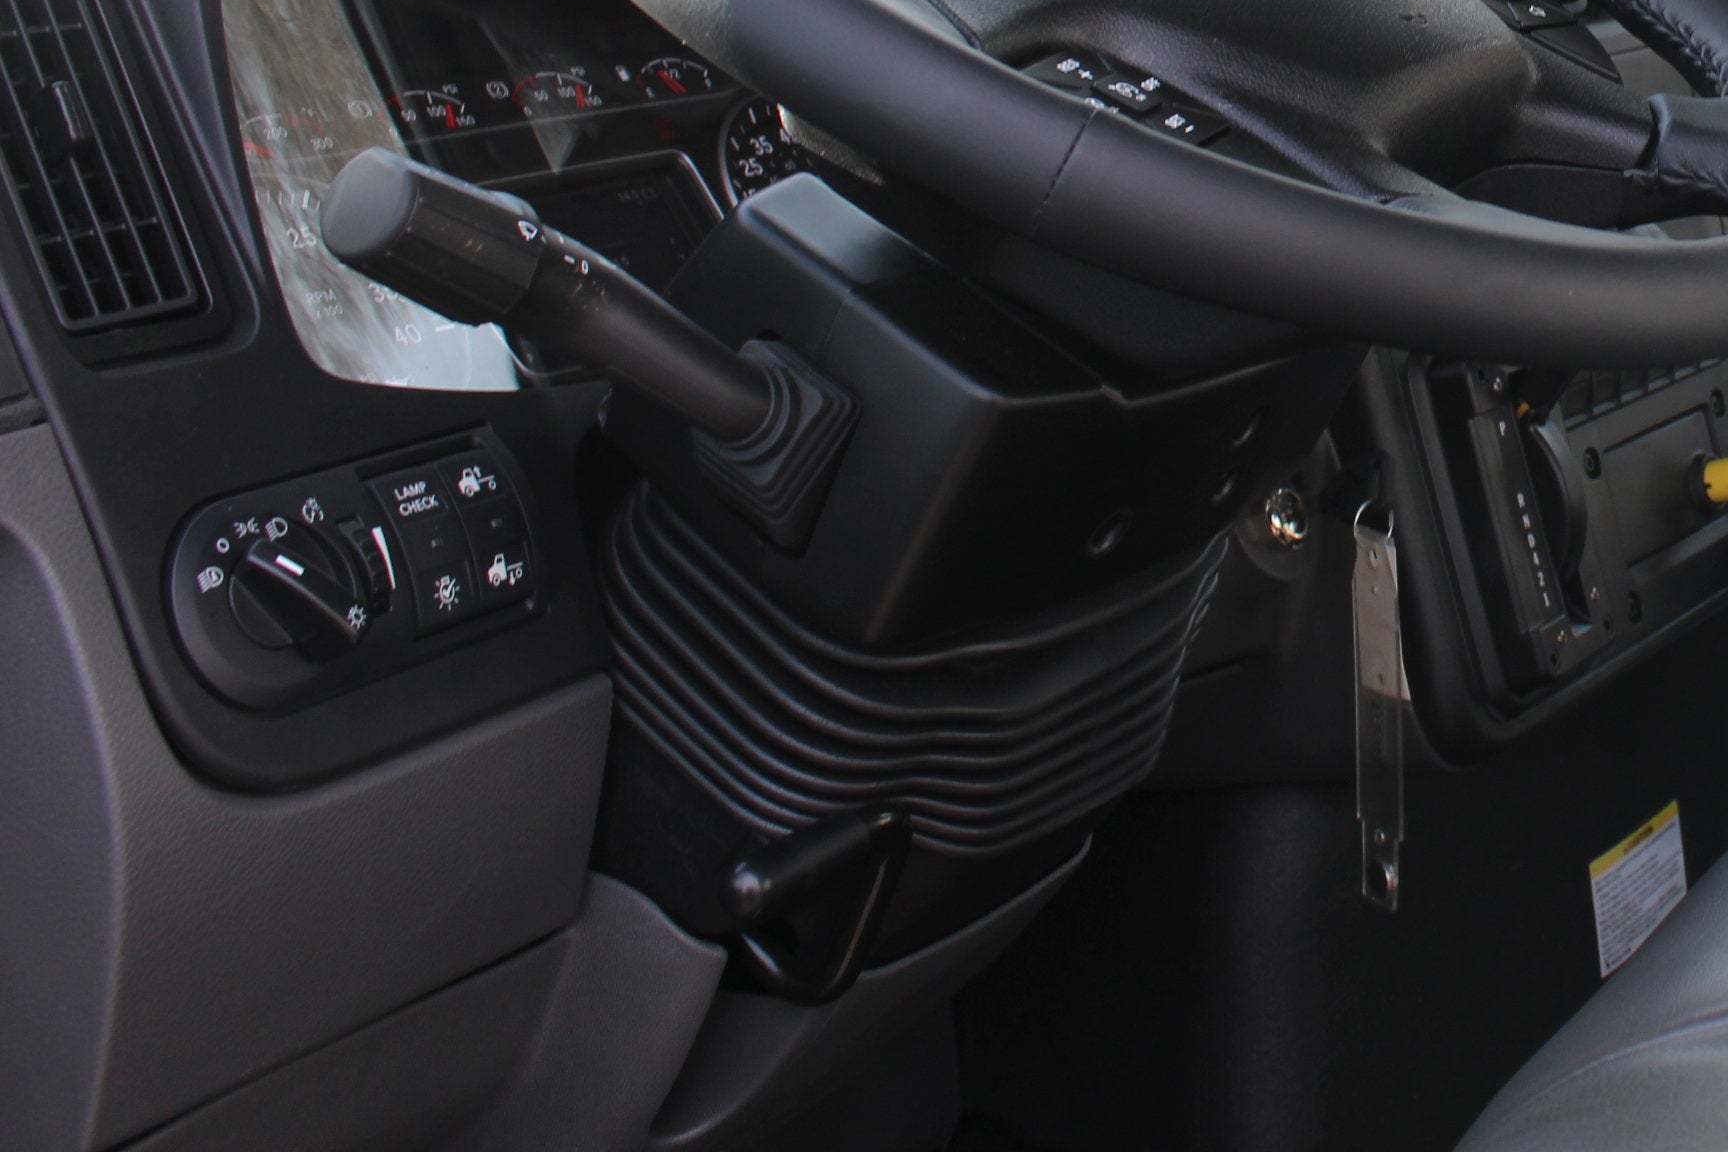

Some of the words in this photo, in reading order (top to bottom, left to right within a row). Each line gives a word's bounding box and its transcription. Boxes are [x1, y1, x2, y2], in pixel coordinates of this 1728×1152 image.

[750, 135, 774, 155] 35
[739, 157, 764, 178] 25
[286, 226, 318, 249] 25
[395, 324, 422, 346] 40
[394, 481, 426, 501] LAMP
[399, 494, 439, 516] CHECK
[1499, 420, 1507, 437] P
[1516, 492, 1526, 509] R
[1522, 513, 1531, 530] N
[1537, 571, 1546, 588] 2
